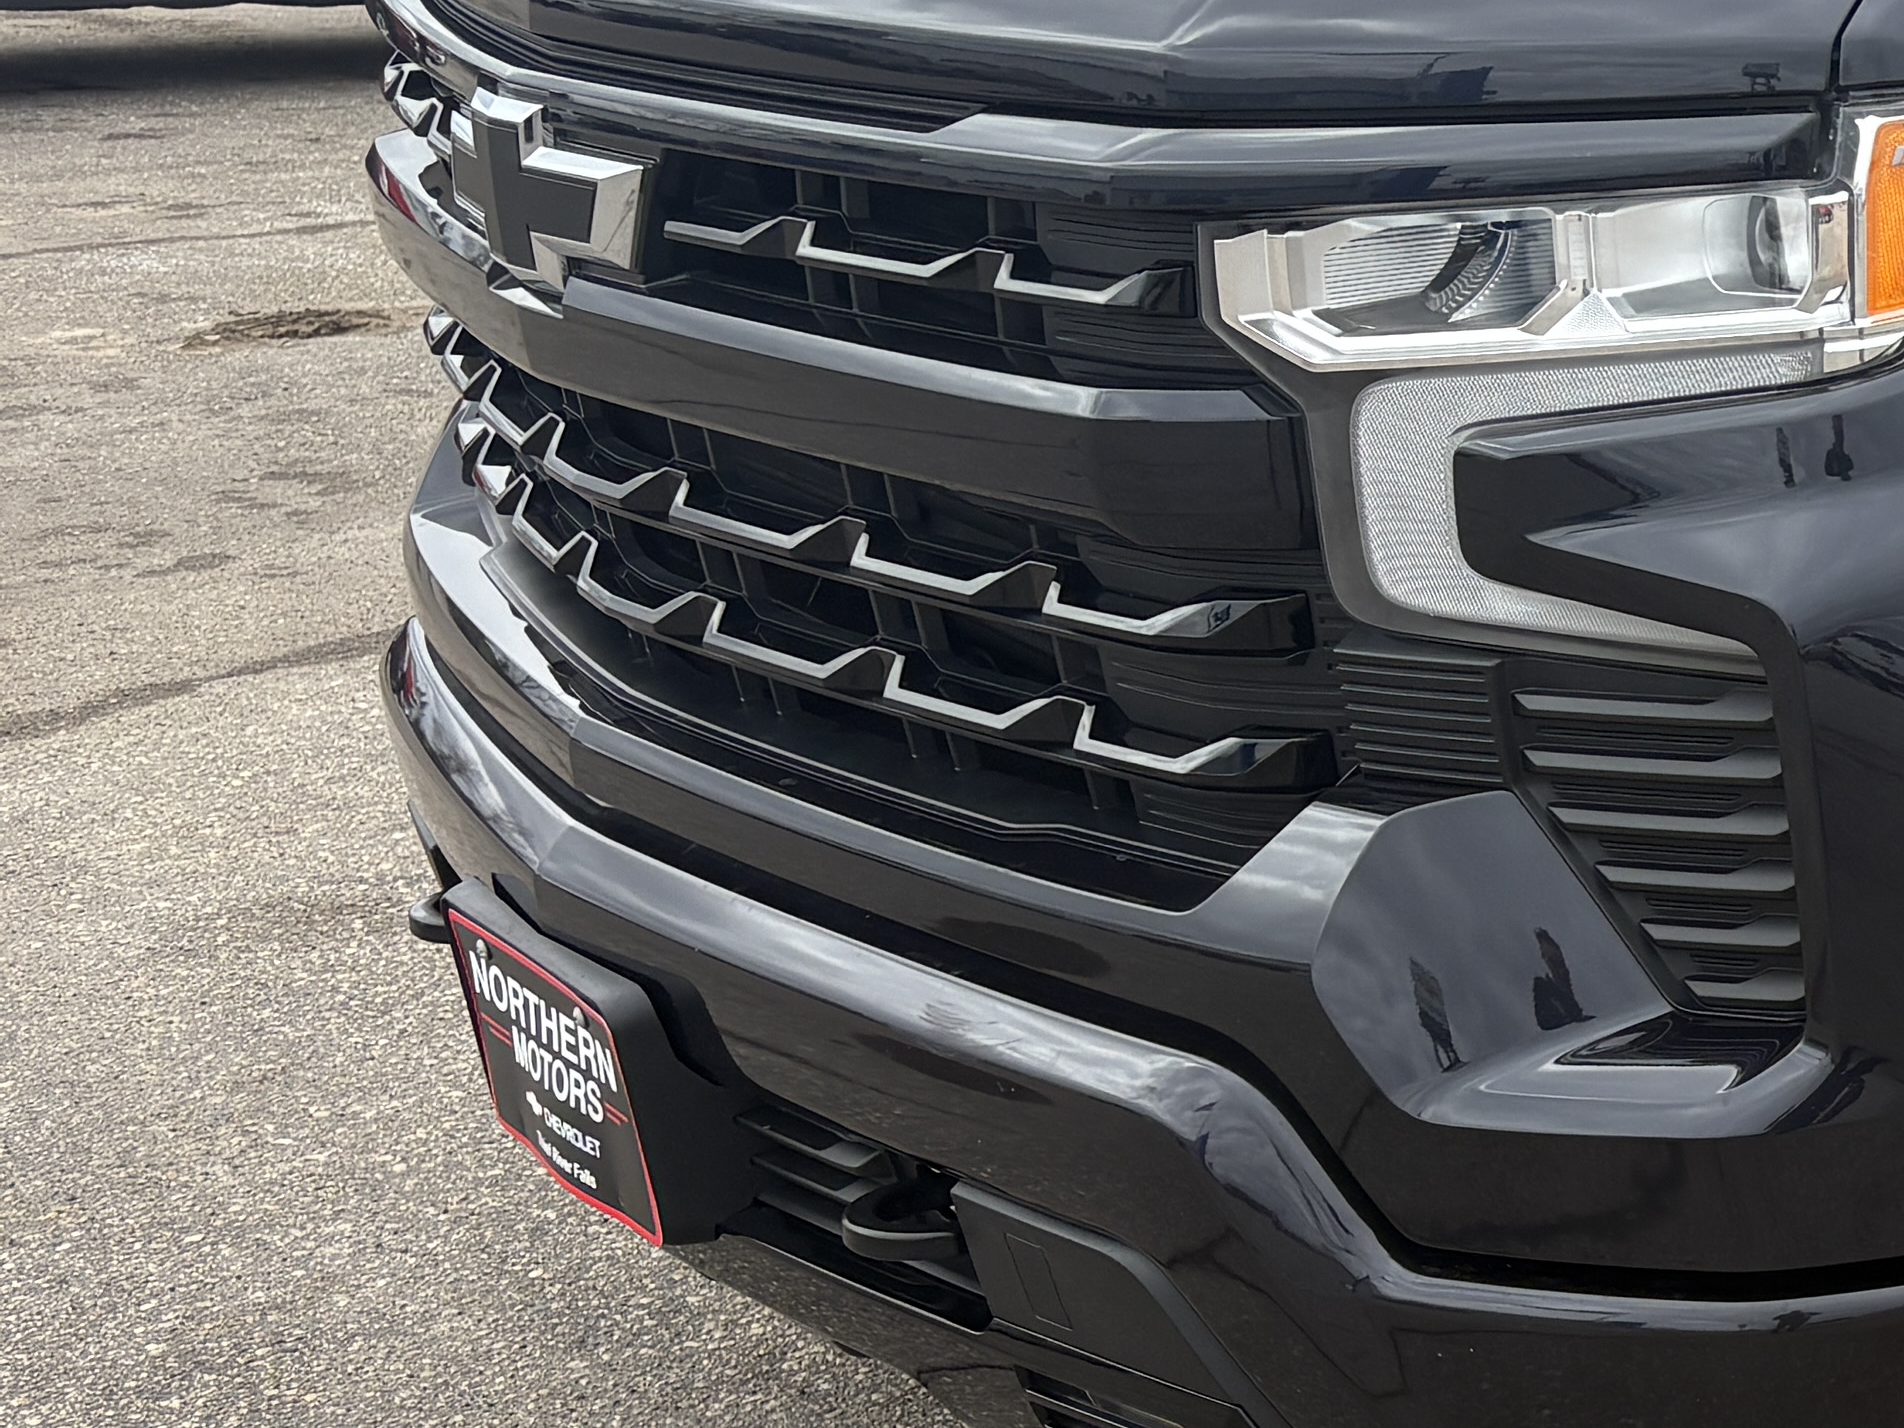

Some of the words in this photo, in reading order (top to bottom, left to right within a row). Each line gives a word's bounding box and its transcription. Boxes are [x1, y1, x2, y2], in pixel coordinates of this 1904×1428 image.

[469, 950, 618, 1093] NORTHERN
[511, 1025, 604, 1123] MOTORS
[543, 1107, 600, 1159] CHEVROLET
